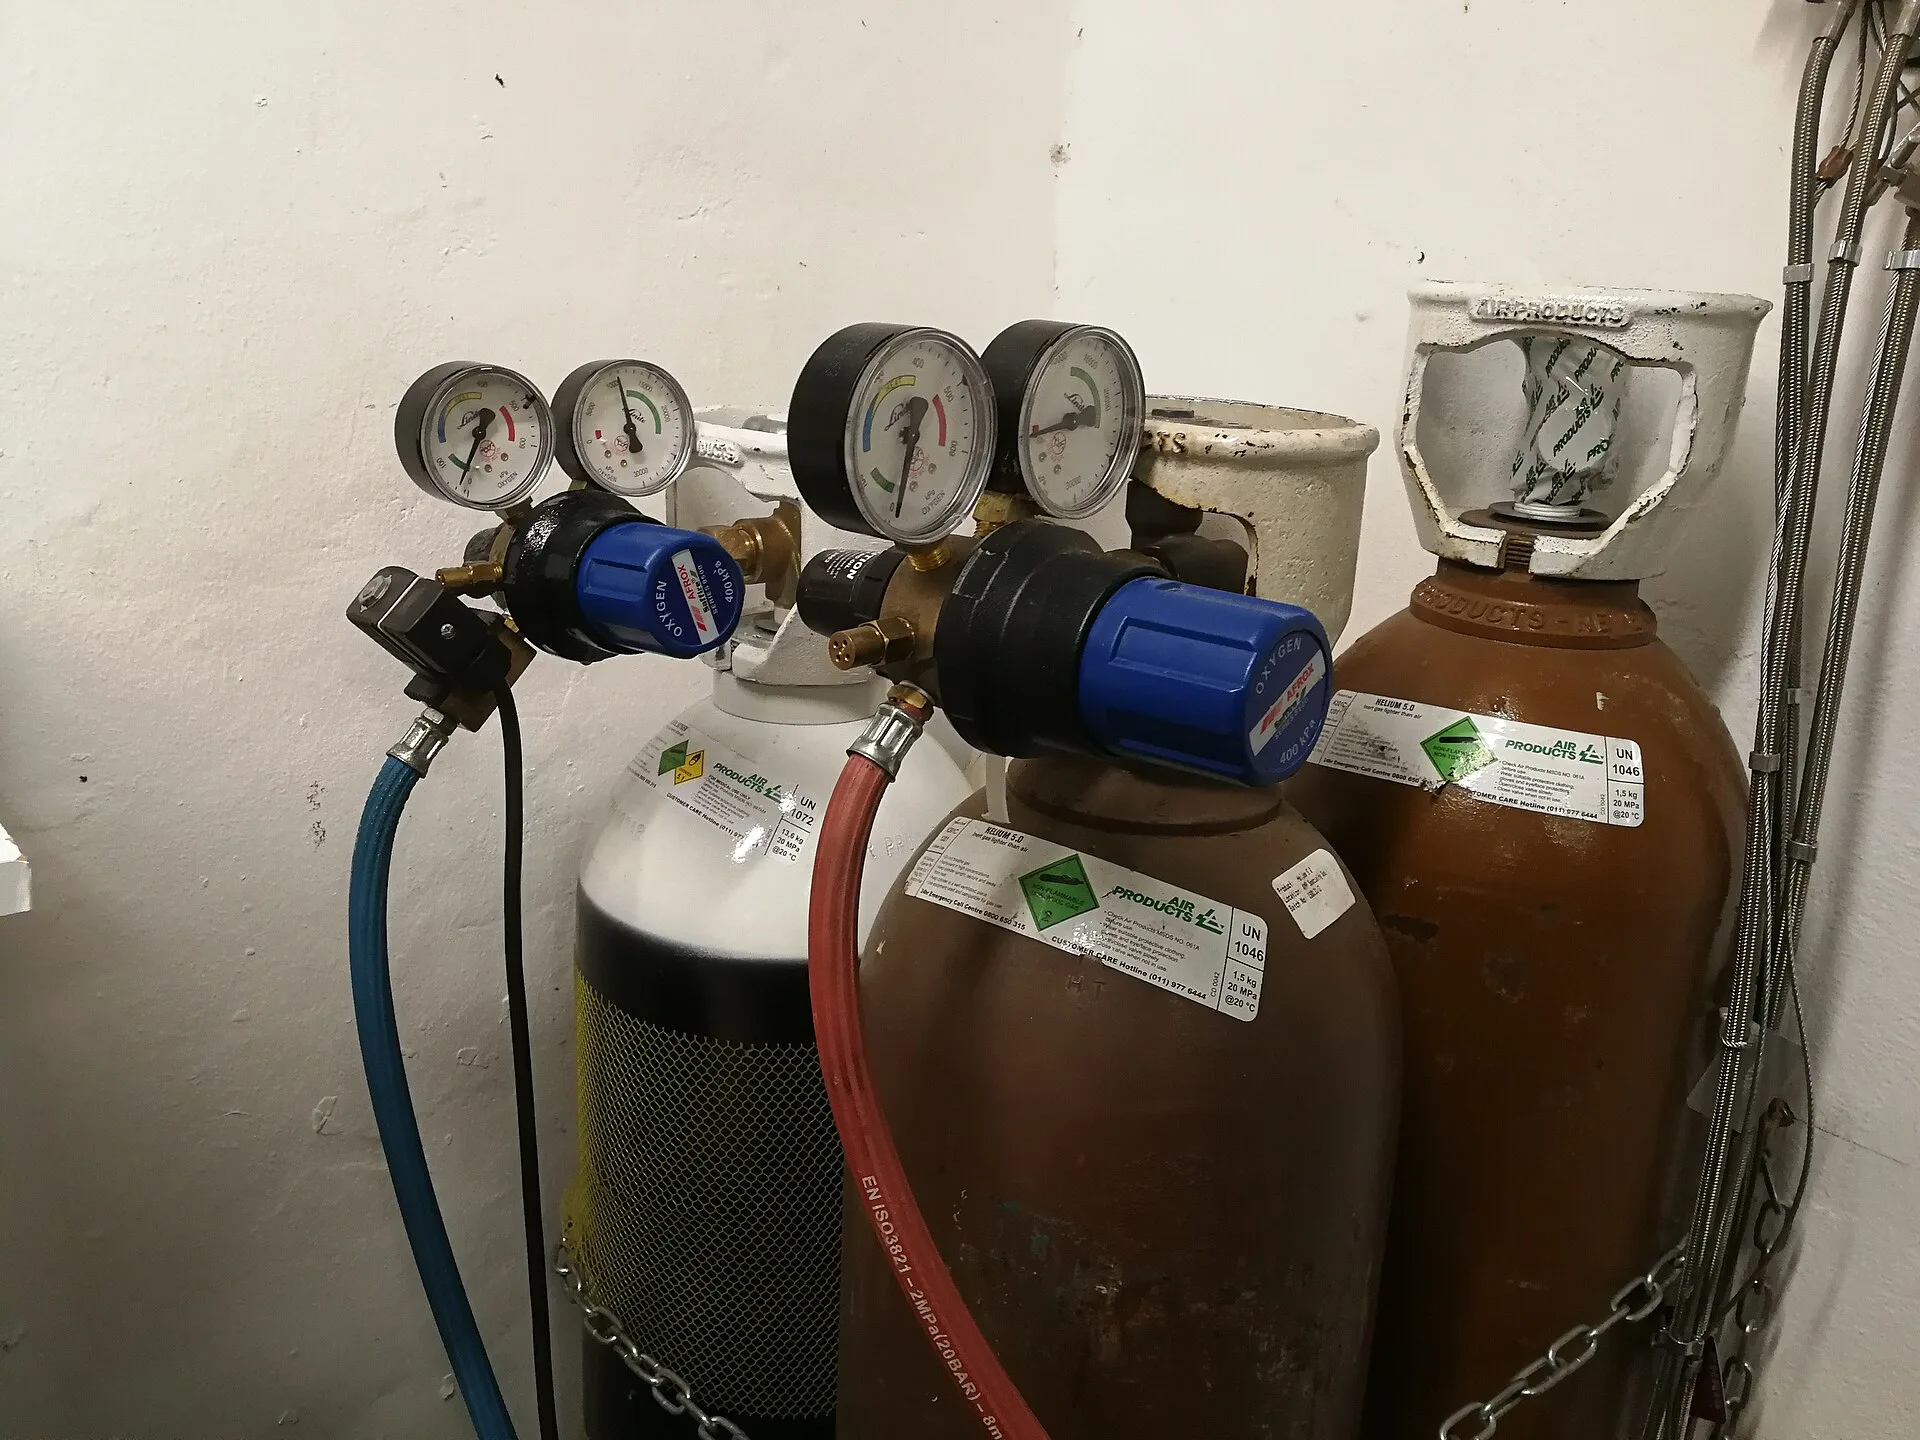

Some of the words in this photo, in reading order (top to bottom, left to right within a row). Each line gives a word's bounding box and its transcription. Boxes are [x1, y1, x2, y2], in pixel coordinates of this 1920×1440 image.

[1553, 408, 1591, 458] PRODUCTS
[714, 559, 732, 583] kPa
[677, 563, 696, 600] AFROX
[722, 581, 734, 604] 400
[655, 580, 683, 638] OXYGEN
[1255, 637, 1302, 695] OXYGEN
[1286, 662, 1315, 702] AFROX
[1375, 698, 1402, 710] HELIUM
[1402, 703, 1415, 712] 5.0
[1279, 742, 1299, 765] 400
[1299, 719, 1317, 745] kPa
[1505, 739, 1577, 760] PRODUCTS
[1553, 740, 1577, 752] AIR
[1616, 748, 1633, 760] UN
[1333, 759, 1359, 771] Emergency
[1360, 765, 1371, 773] Call
[1371, 768, 1391, 777] Centre
[1612, 763, 1640, 777] 1046
[713, 762, 764, 793] PRODUCTS
[748, 773, 768, 787] AIR
[800, 796, 817, 811] UN
[1498, 795, 1518, 806] CARE
[1519, 800, 1545, 811] Hotline
[1628, 790, 1638, 800] kg
[1613, 799, 1622, 807] 20
[1623, 801, 1640, 810] MPa
[666, 792, 690, 809] CUSTOMER
[688, 805, 702, 816] CARE
[701, 813, 720, 827] Hotline
[719, 823, 734, 836] (011)
[791, 808, 814, 826] 1072
[1613, 810, 1629, 819] @20
[1631, 812, 1640, 820] °C
[776, 836, 786, 845] 20
[785, 841, 800, 853] MPa
[795, 835, 804, 845] kg
[1012, 833, 1025, 844] 5.0
[772, 845, 788, 857] @20
[789, 853, 797, 861] °C
[928, 891, 953, 905] Emergency
[953, 899, 964, 908] Call
[964, 903, 983, 915] Centre
[983, 910, 999, 921] 0800
[999, 915, 1013, 926] 650
[1012, 920, 1026, 931] 315
[1112, 885, 1193, 923] PRODUCTS
[1168, 896, 1196, 913] AIR
[1133, 919, 1157, 934] Products
[1242, 923, 1261, 942] UN
[1138, 936, 1164, 951] protective
[1234, 940, 1265, 962] 1046
[1051, 935, 1095, 957] CUSTOMER
[1096, 952, 1118, 965] CARE
[1119, 960, 1148, 978] Hotline
[1148, 973, 1170, 987] (011)
[1170, 980, 1186, 992] 977
[1187, 987, 1207, 1000] 6444
[1227, 982, 1238, 992] 20
[1239, 986, 1257, 1000] MPa
[1246, 976, 1257, 989] kg
[1225, 995, 1244, 1008] @20
[1245, 1001, 1256, 1013] °C
[862, 1175, 882, 1201] EN
[910, 1290, 981, 1401] 2MPa(20BAR)
